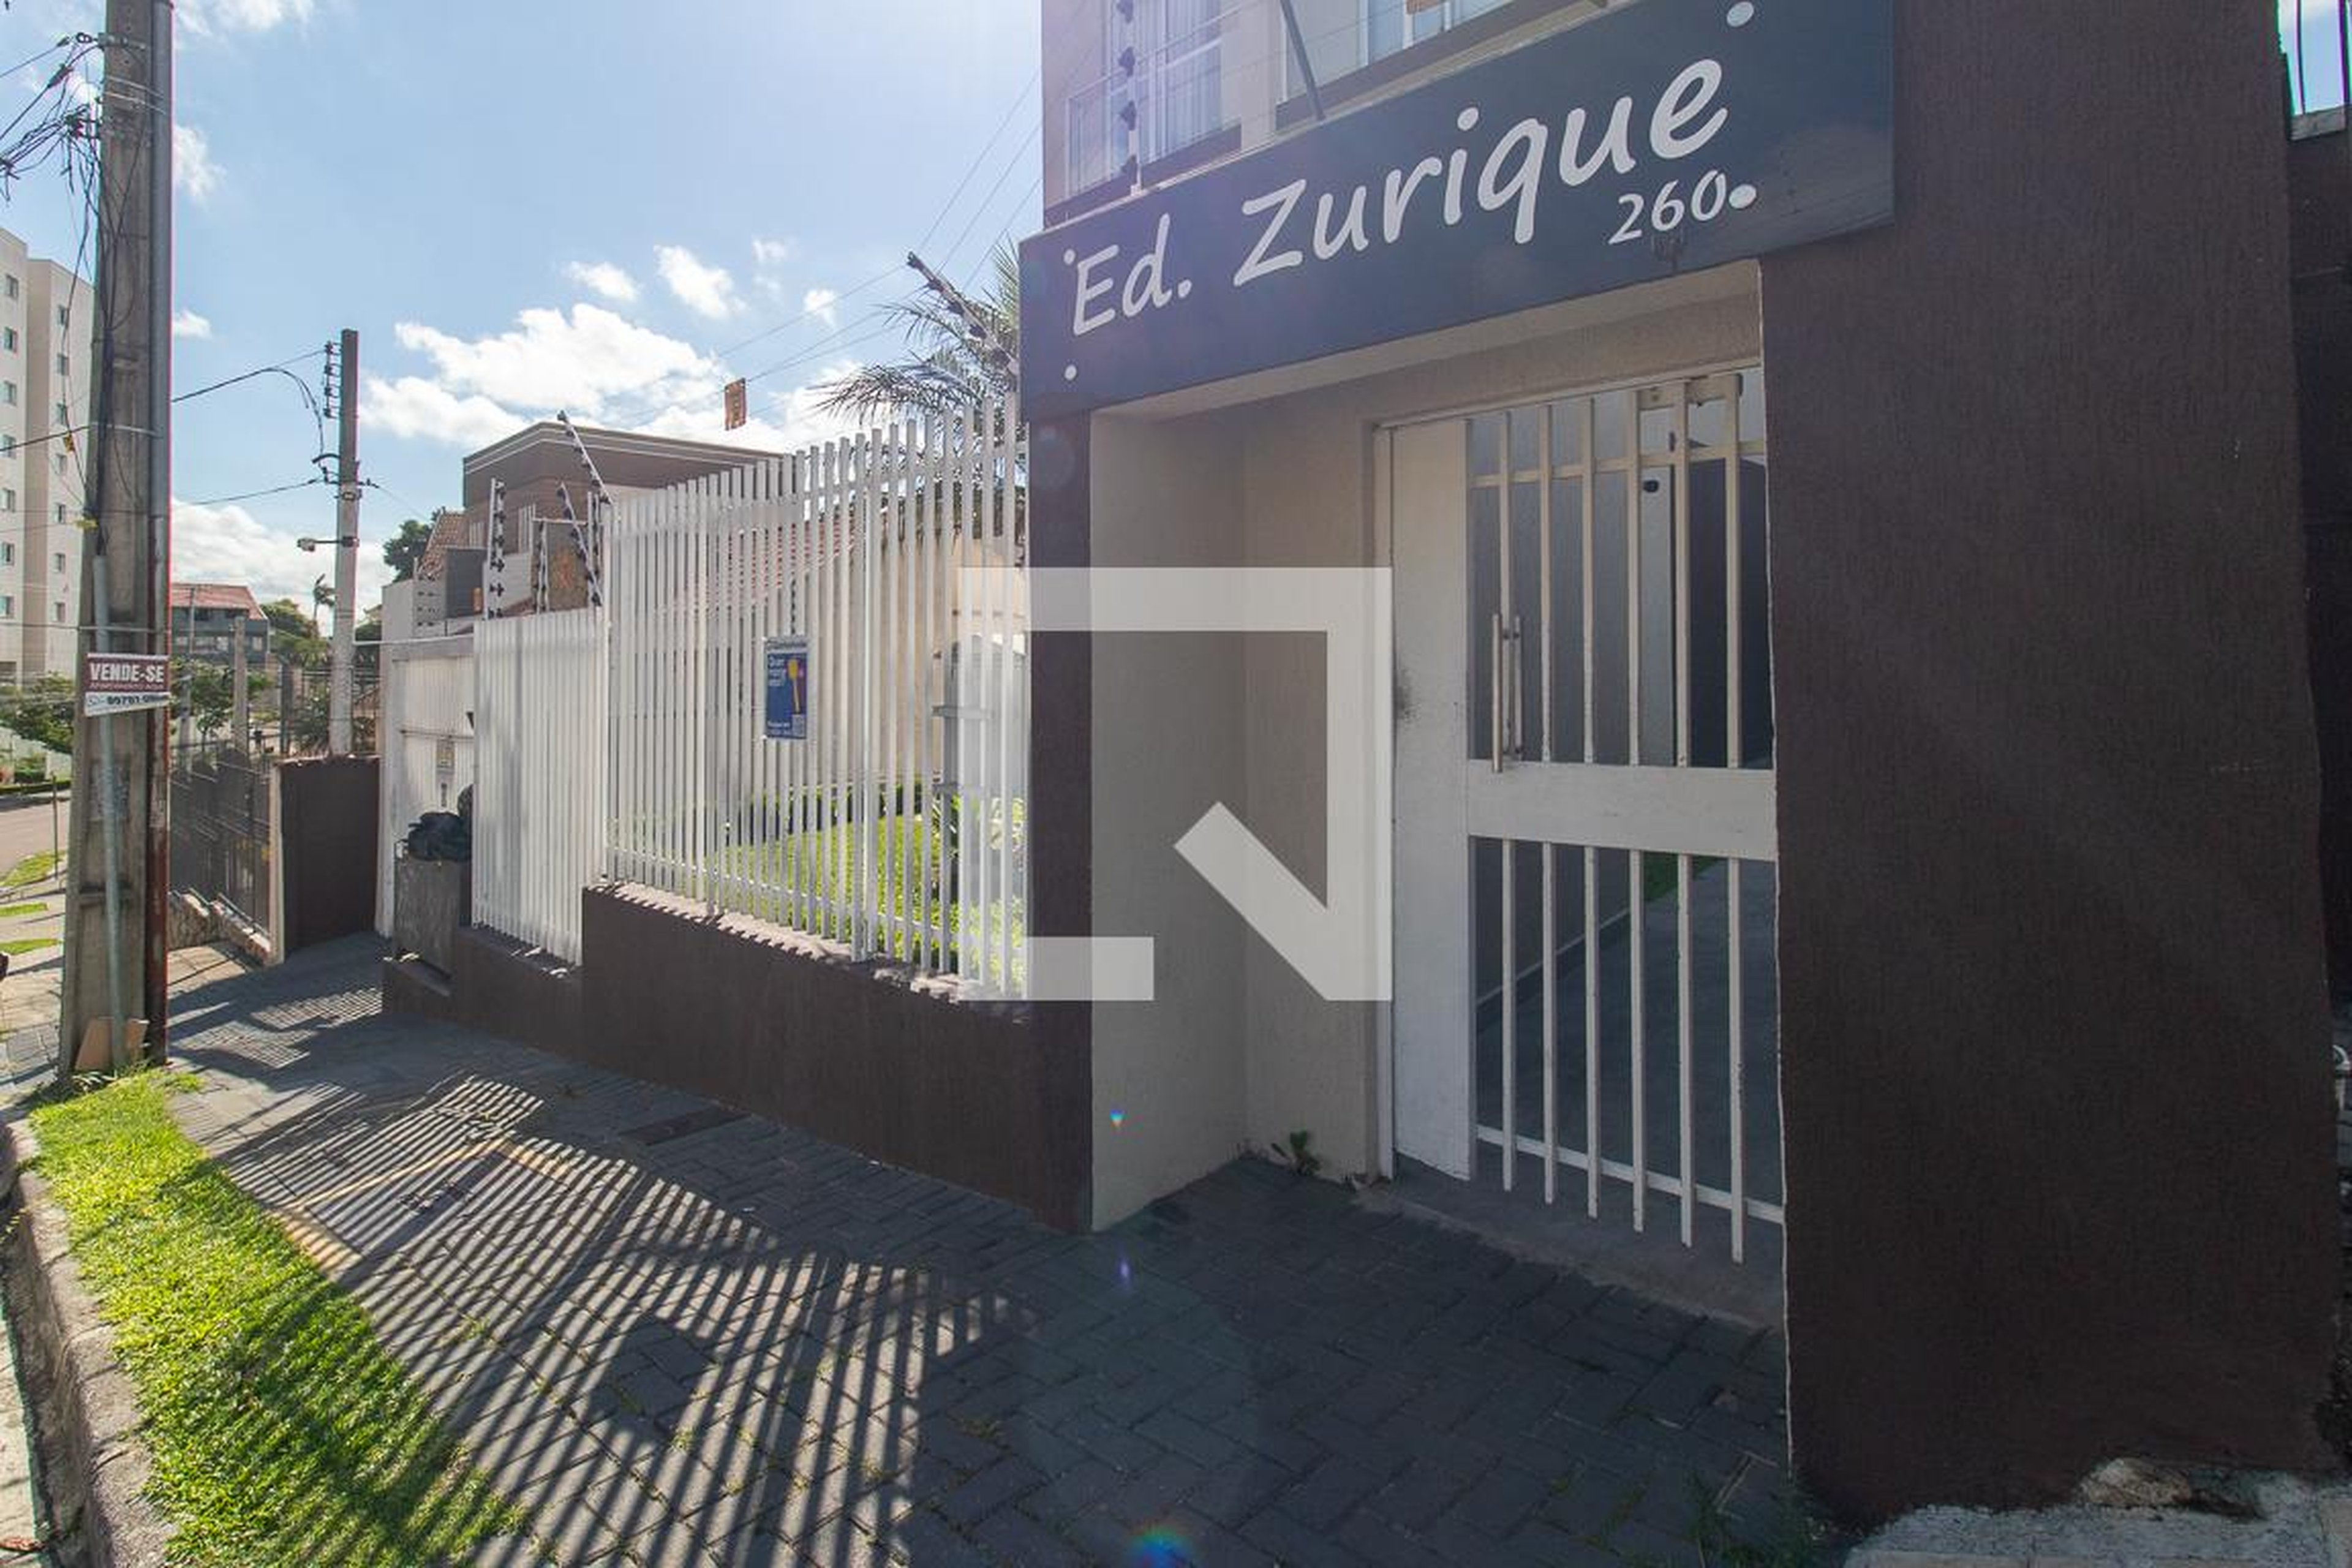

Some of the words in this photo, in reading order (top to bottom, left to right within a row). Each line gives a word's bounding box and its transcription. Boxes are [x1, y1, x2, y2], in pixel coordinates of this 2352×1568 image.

[1074, 214, 1191, 334] Ed.
[1234, 60, 1727, 285] Zurique
[1610, 171, 1727, 243] 260
[89, 663, 164, 682] VENDE-SE
